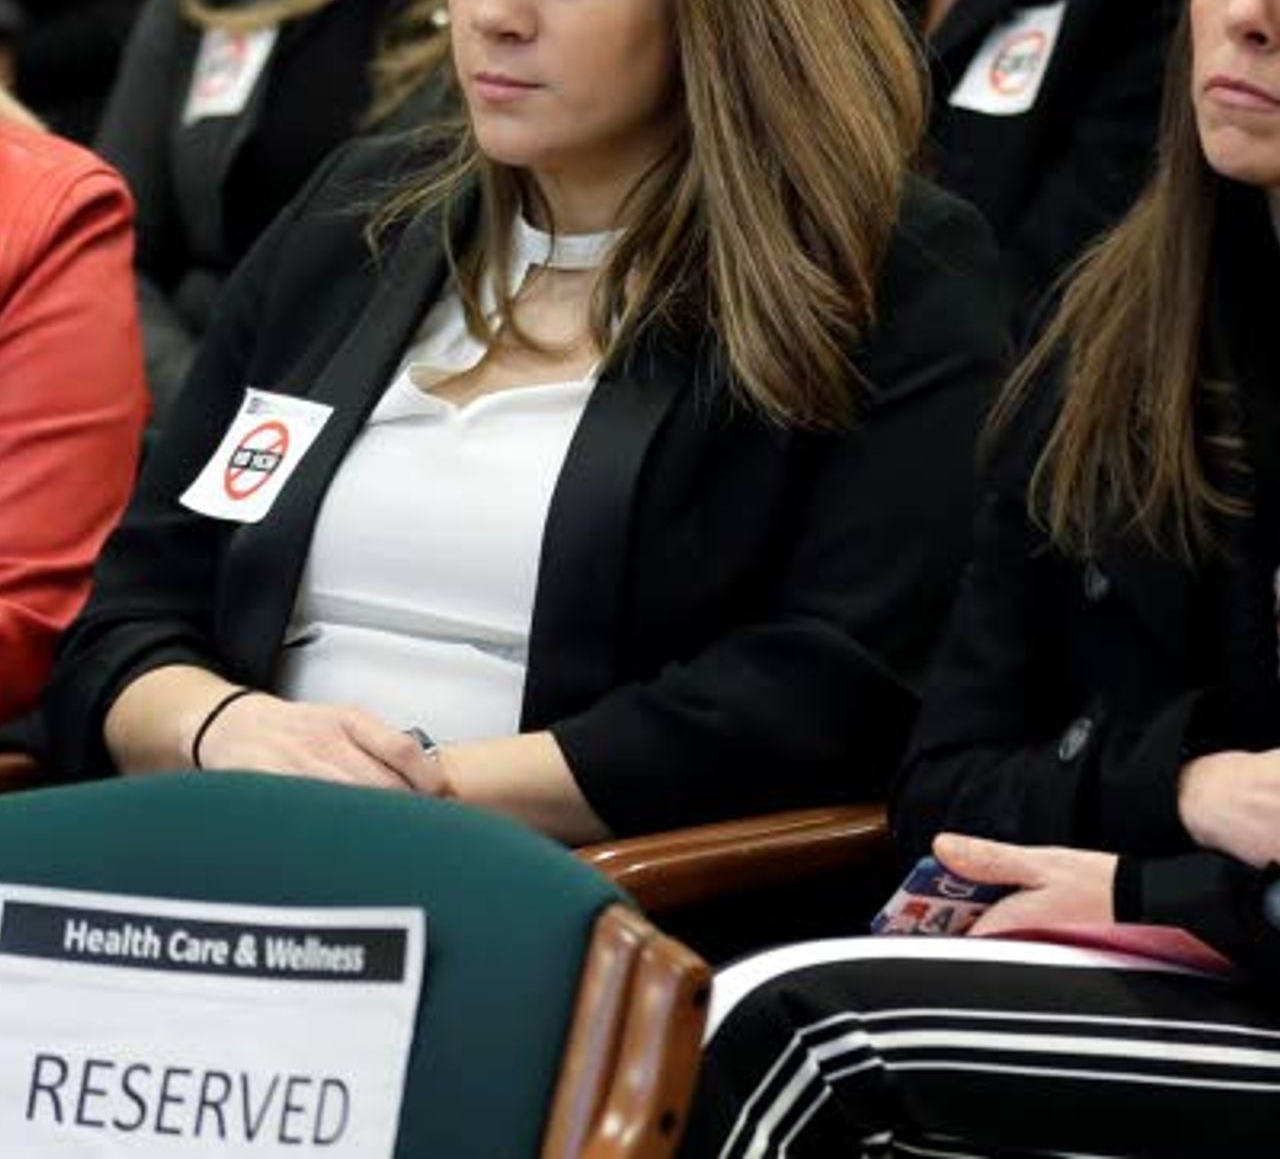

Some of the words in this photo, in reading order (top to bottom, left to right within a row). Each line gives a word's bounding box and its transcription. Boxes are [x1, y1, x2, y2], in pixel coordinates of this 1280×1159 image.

[63, 918, 160, 959] Health
[168, 929, 228, 965] Care
[233, 934, 257, 968] &
[265, 936, 365, 972] Wellness
[25, 1053, 350, 1147] RESERVED
